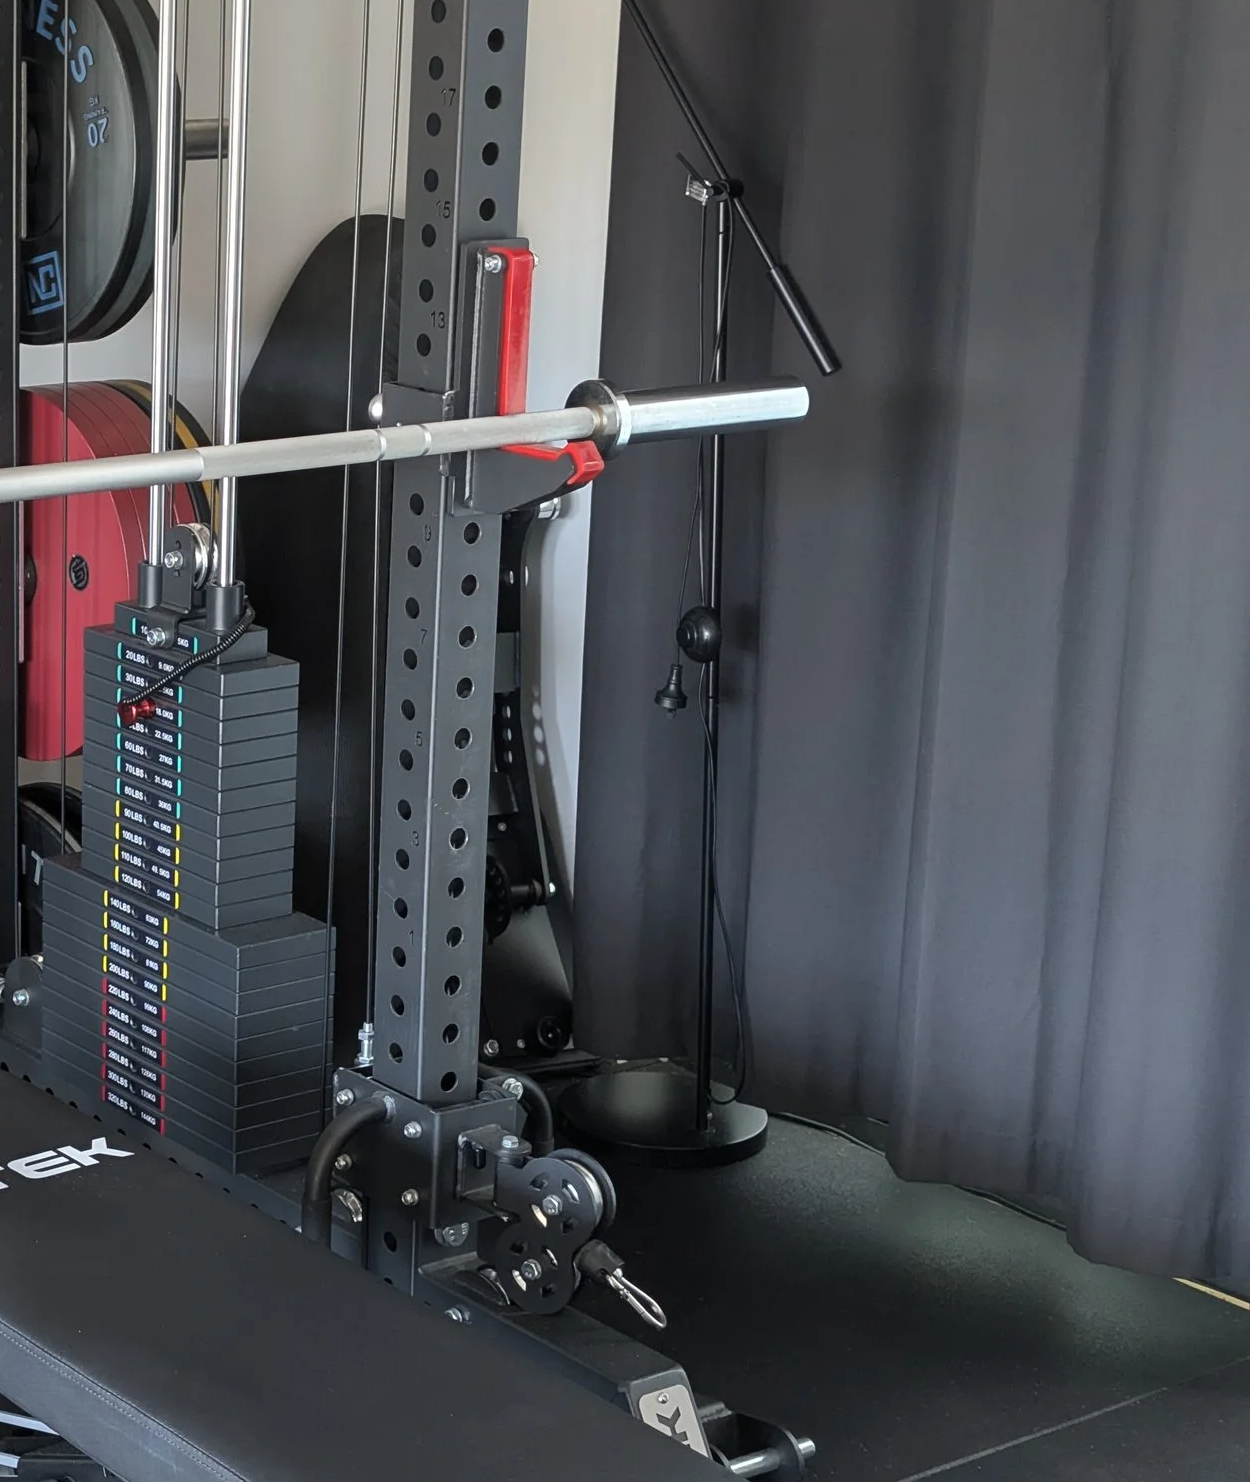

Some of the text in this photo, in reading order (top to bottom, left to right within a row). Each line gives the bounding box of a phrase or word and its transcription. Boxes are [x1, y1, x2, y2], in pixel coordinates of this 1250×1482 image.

[441, 87, 456, 107] 17
[87, 117, 109, 148] 20
[435, 199, 451, 220] 15
[430, 309, 446, 329] 13
[420, 628, 428, 646] 7
[126, 650, 145, 664] 20LBS
[125, 672, 145, 687] 30LBS
[129, 722, 174, 743] LBS 22.5KG
[415, 730, 423, 747] 5
[124, 740, 173, 766] 60LBS 27KG
[125, 763, 173, 789] 70LBS 31.5KG
[124, 786, 144, 801] 80LBS
[123, 808, 143, 823] 90LBS
[122, 830, 143, 846] 100LBS
[411, 830, 420, 847] 3
[121, 851, 142, 867] 110LBS
[121, 873, 142, 889] 120LBS
[110, 897, 131, 914] 140LBS
[145, 936, 159, 949] 72KG
[108, 962, 130, 980] 200LBS
[108, 984, 129, 1002] 220LBS
[108, 1006, 129, 1024] 240LBS
